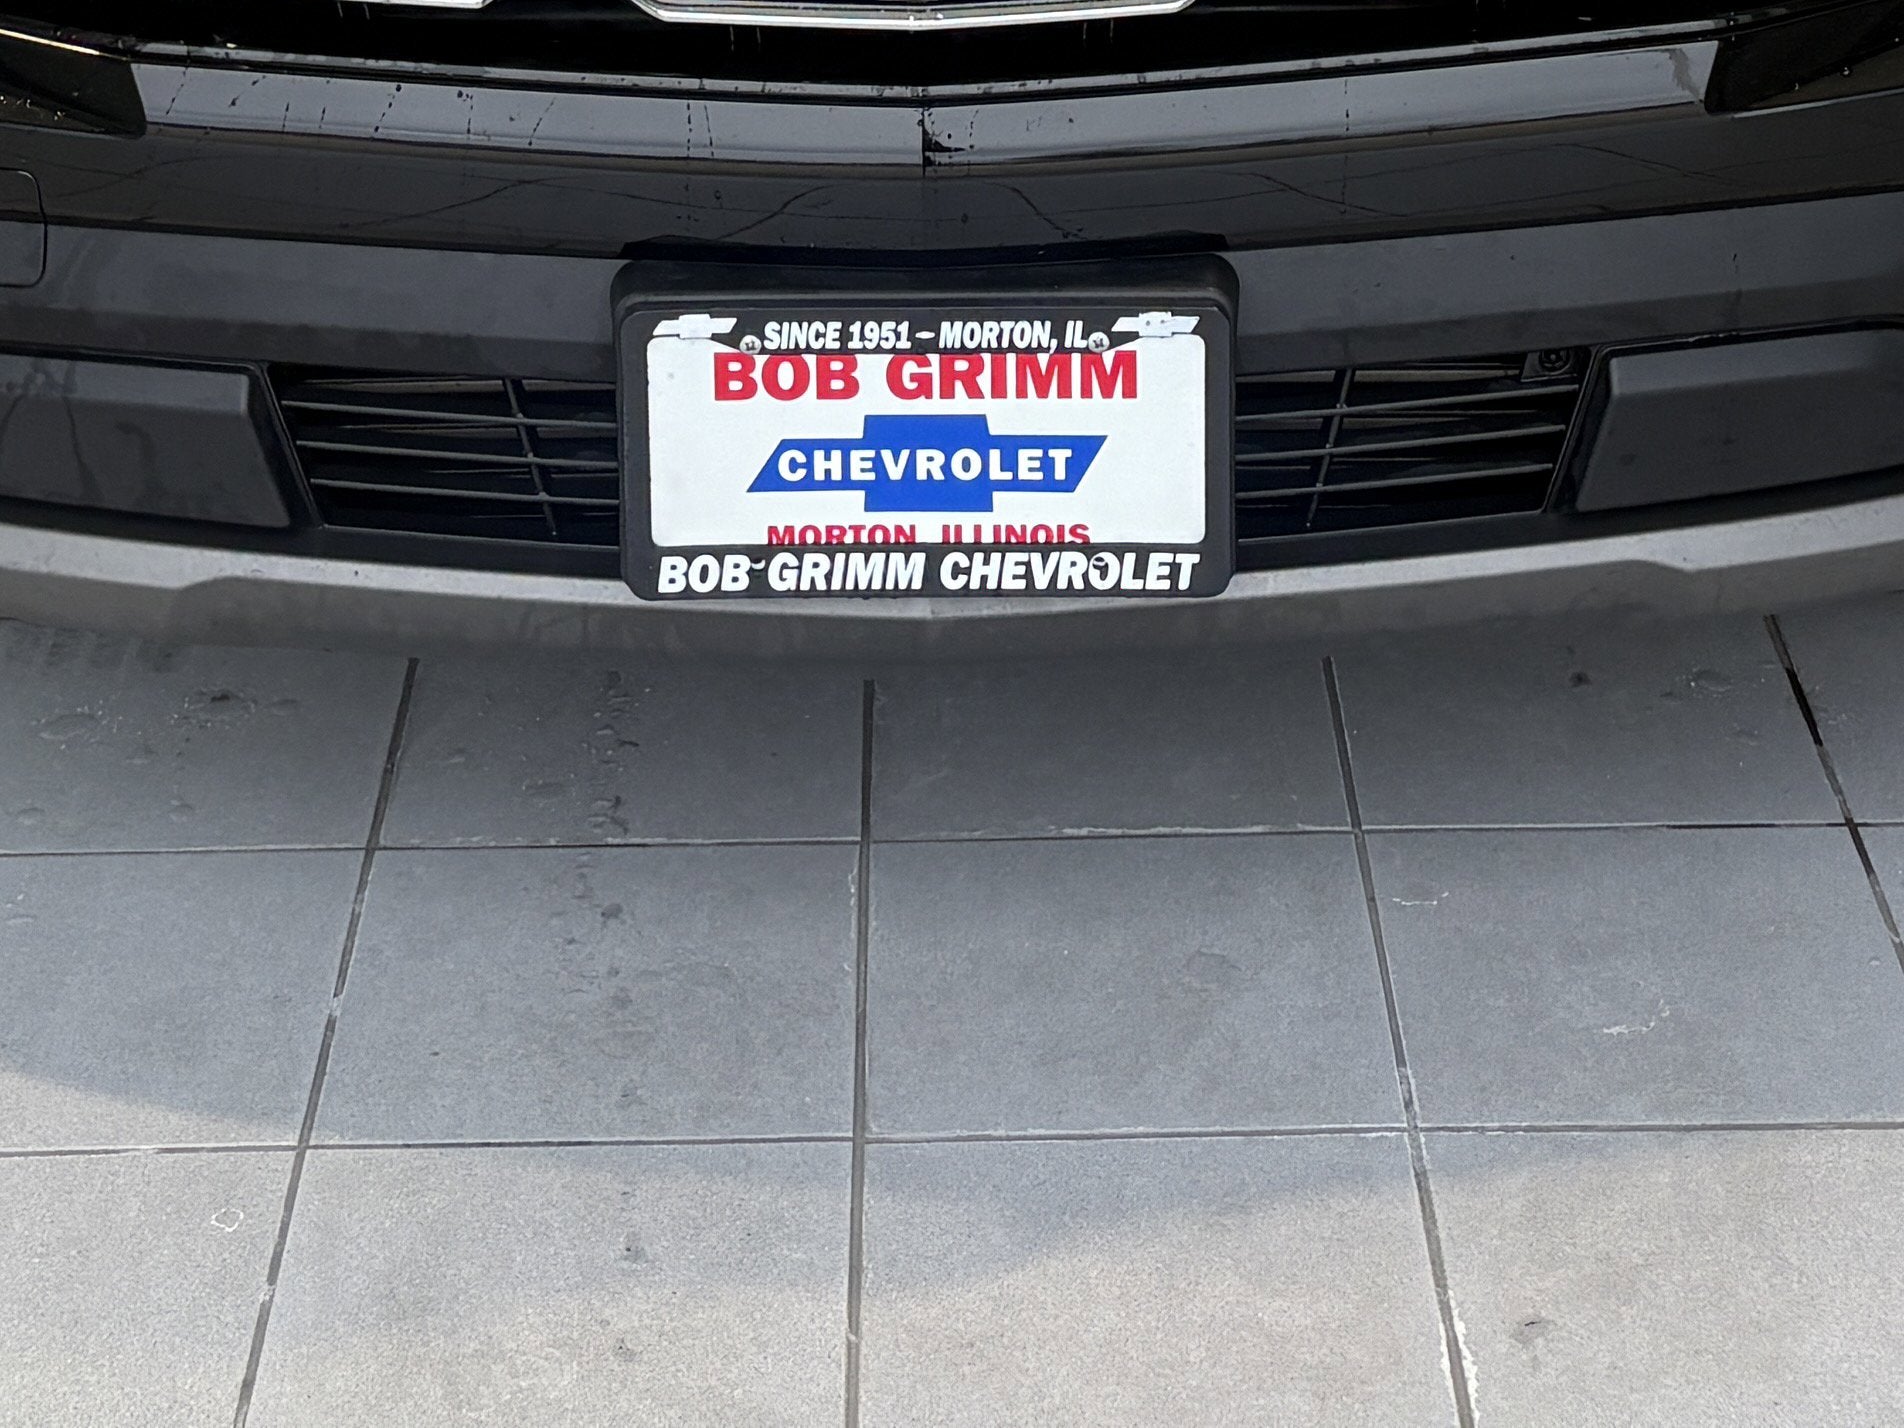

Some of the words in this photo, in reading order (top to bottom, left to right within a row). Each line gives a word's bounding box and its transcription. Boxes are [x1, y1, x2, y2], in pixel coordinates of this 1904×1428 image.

[763, 320, 843, 350] SINCE
[847, 320, 912, 350] 1951
[938, 320, 1058, 354] MORTON,
[1064, 320, 1088, 349] IL
[713, 352, 860, 401] BOB
[885, 350, 1138, 400] GRIMM
[777, 448, 1073, 482] CHEVROLET
[657, 554, 753, 594] BOB
[767, 552, 927, 592] GRIMM
[939, 551, 1201, 591] CHEVROLET
